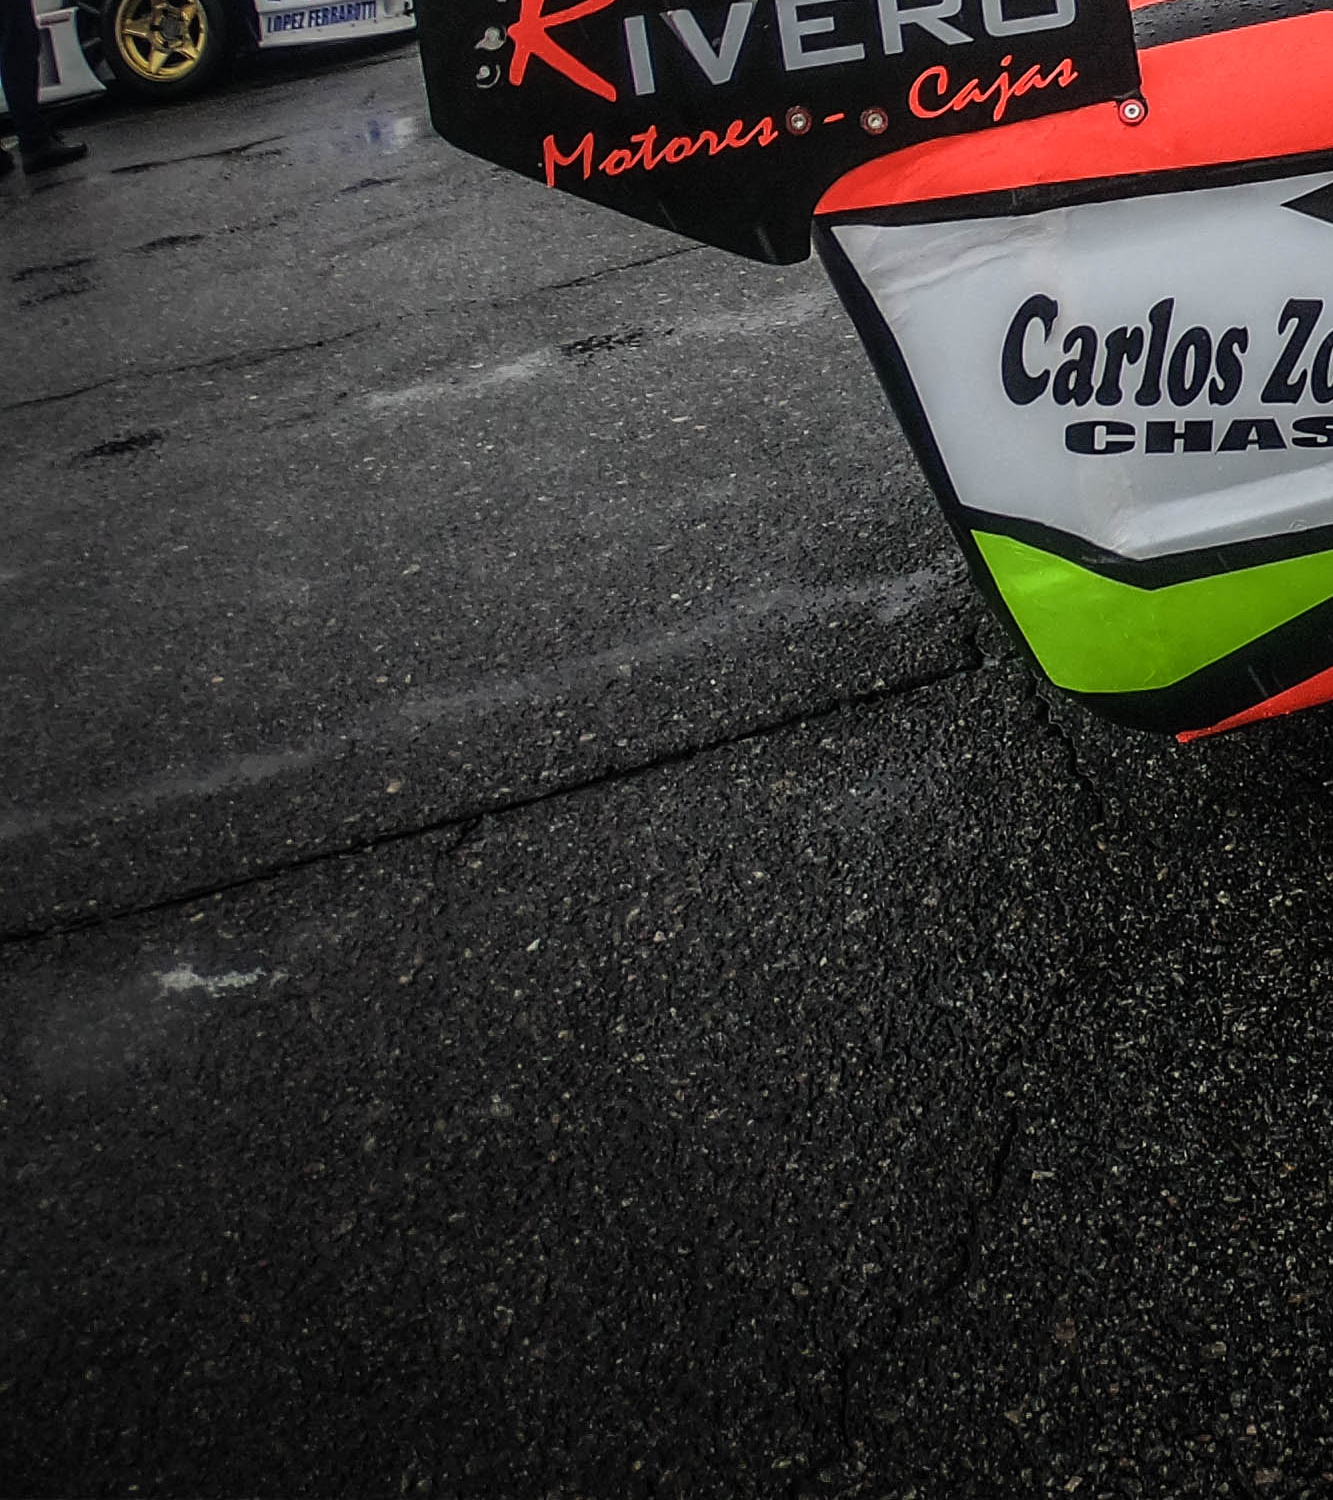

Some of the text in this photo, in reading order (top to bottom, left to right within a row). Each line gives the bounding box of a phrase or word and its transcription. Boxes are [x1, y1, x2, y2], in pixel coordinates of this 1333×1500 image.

[268, 11, 305, 33] LOPEZ
[542, 112, 779, 188] Motores
[908, 54, 1079, 122] Cajas
[1000, 293, 1248, 407] Carlos
